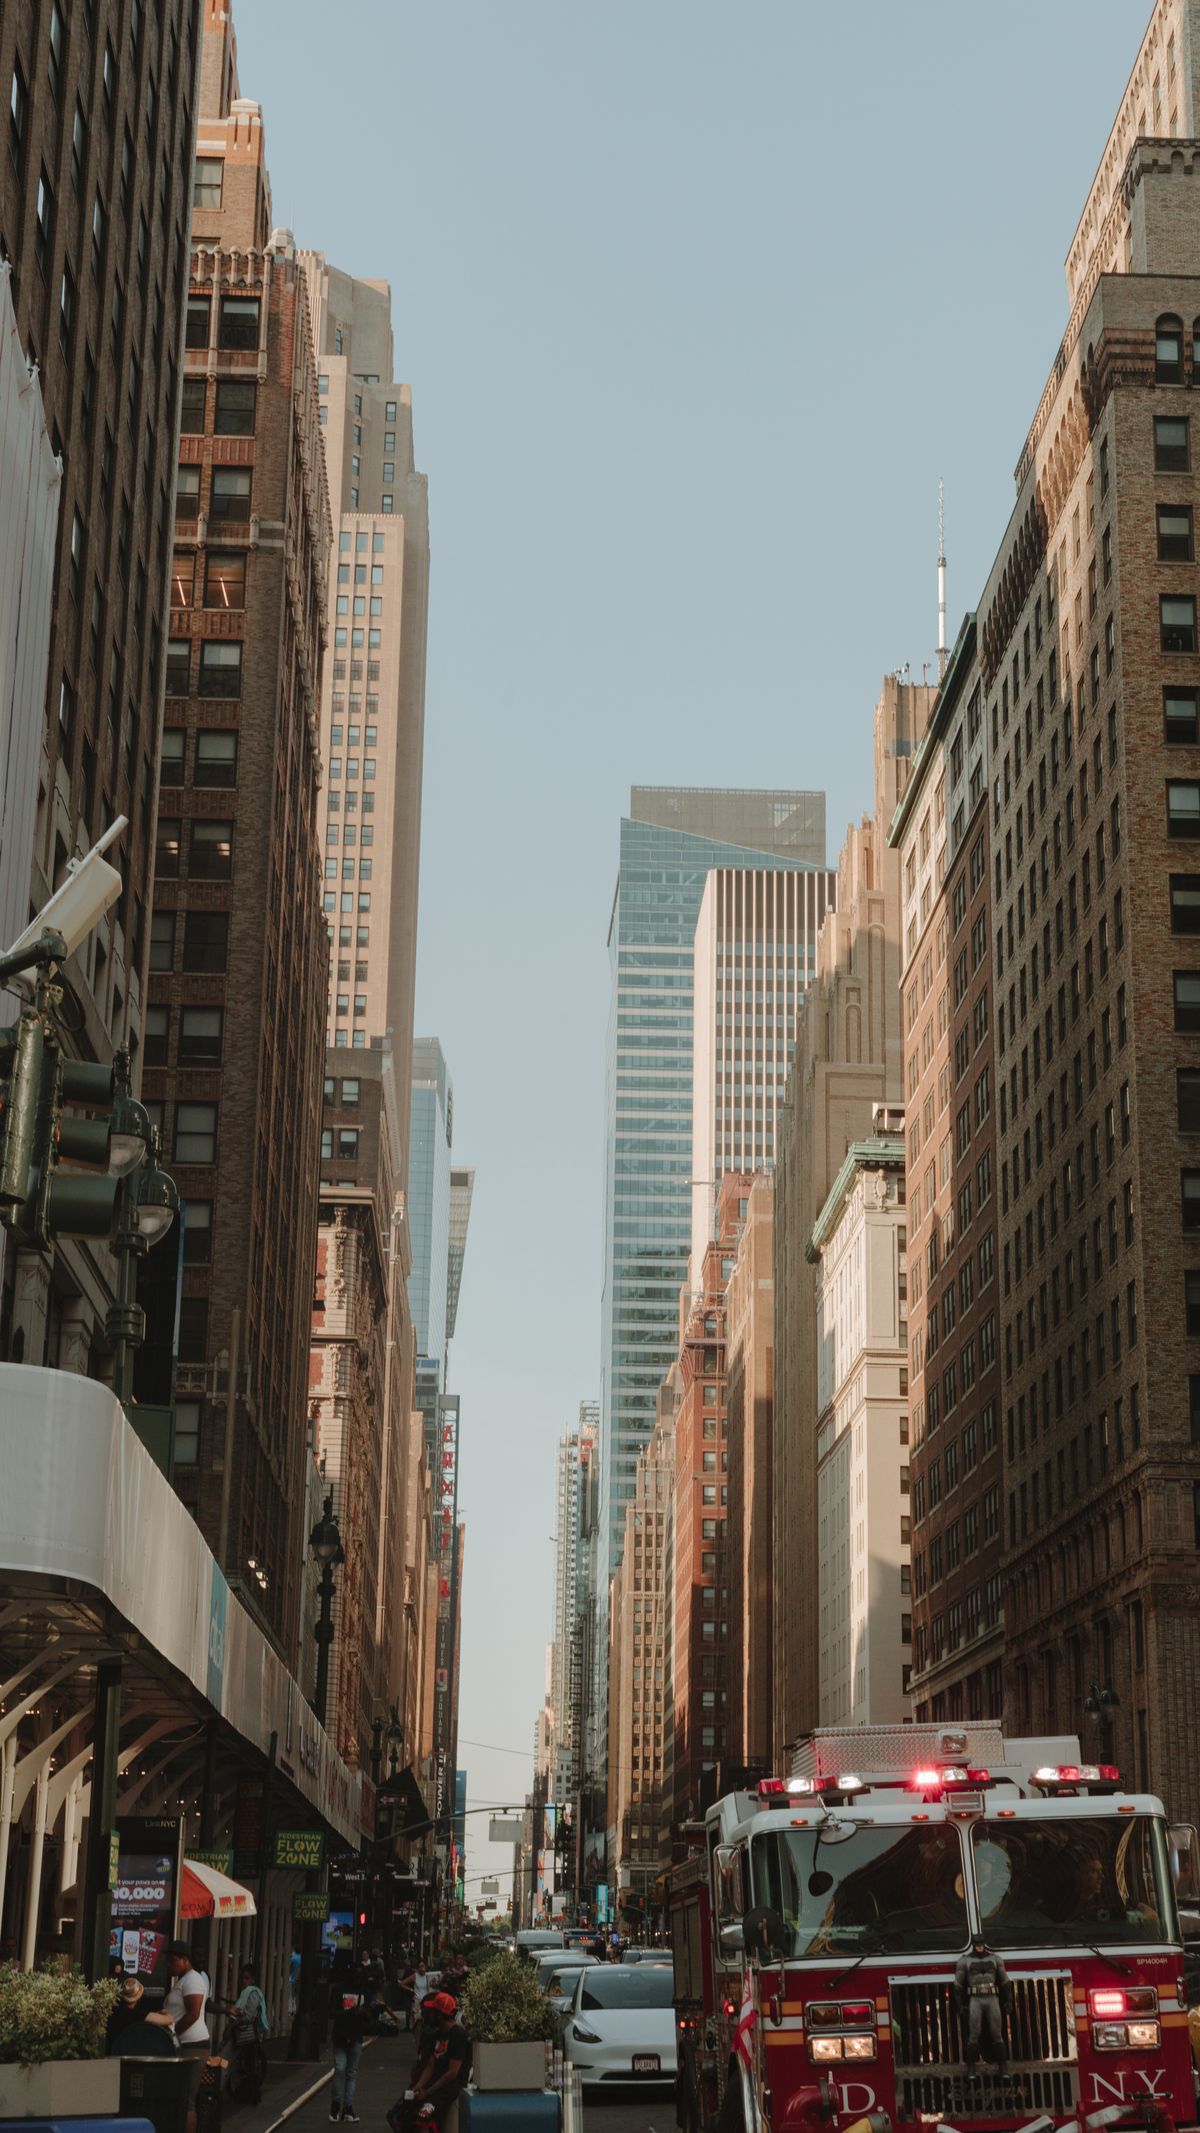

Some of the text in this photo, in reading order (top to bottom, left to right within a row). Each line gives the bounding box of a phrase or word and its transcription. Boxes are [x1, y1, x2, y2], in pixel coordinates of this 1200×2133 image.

[278, 1833, 321, 1841] PEDESTRIAN
[276, 1840, 320, 1852] FLOW
[276, 1852, 320, 1865] ZONE
[295, 1900, 328, 1909] FLOW
[295, 1909, 328, 1919] ZONE
